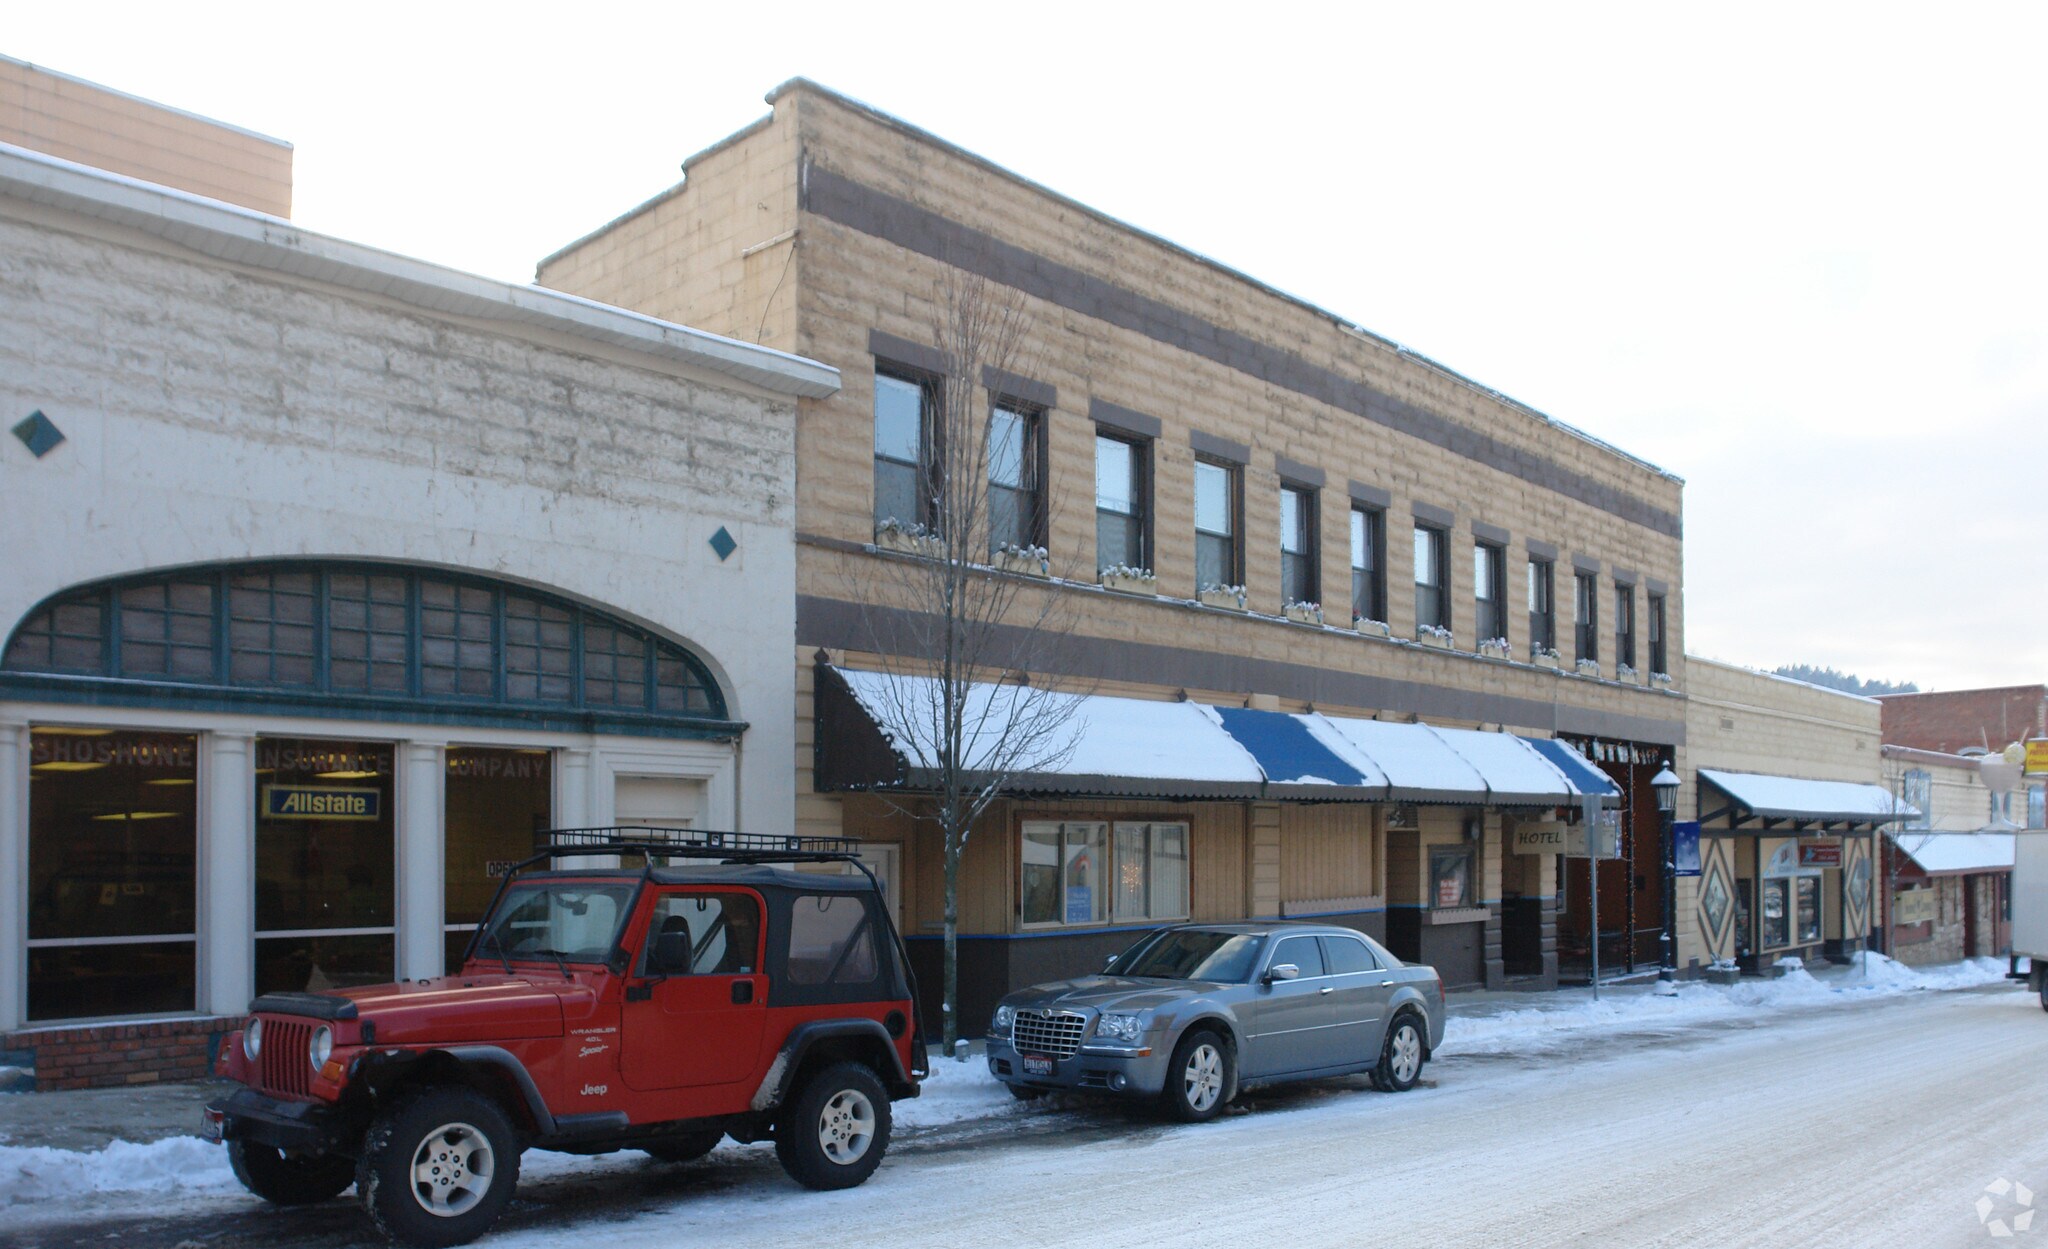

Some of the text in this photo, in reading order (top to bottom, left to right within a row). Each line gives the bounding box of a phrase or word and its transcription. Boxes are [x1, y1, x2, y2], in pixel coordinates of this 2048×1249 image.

[35, 738, 544, 778] SHOSHONE INSURANCE COMPANY
[281, 793, 366, 814] Allstate
[1519, 831, 1562, 844] HOTEL
[570, 1027, 617, 1035] WRANGLER
[580, 1083, 608, 1096] Jeep
